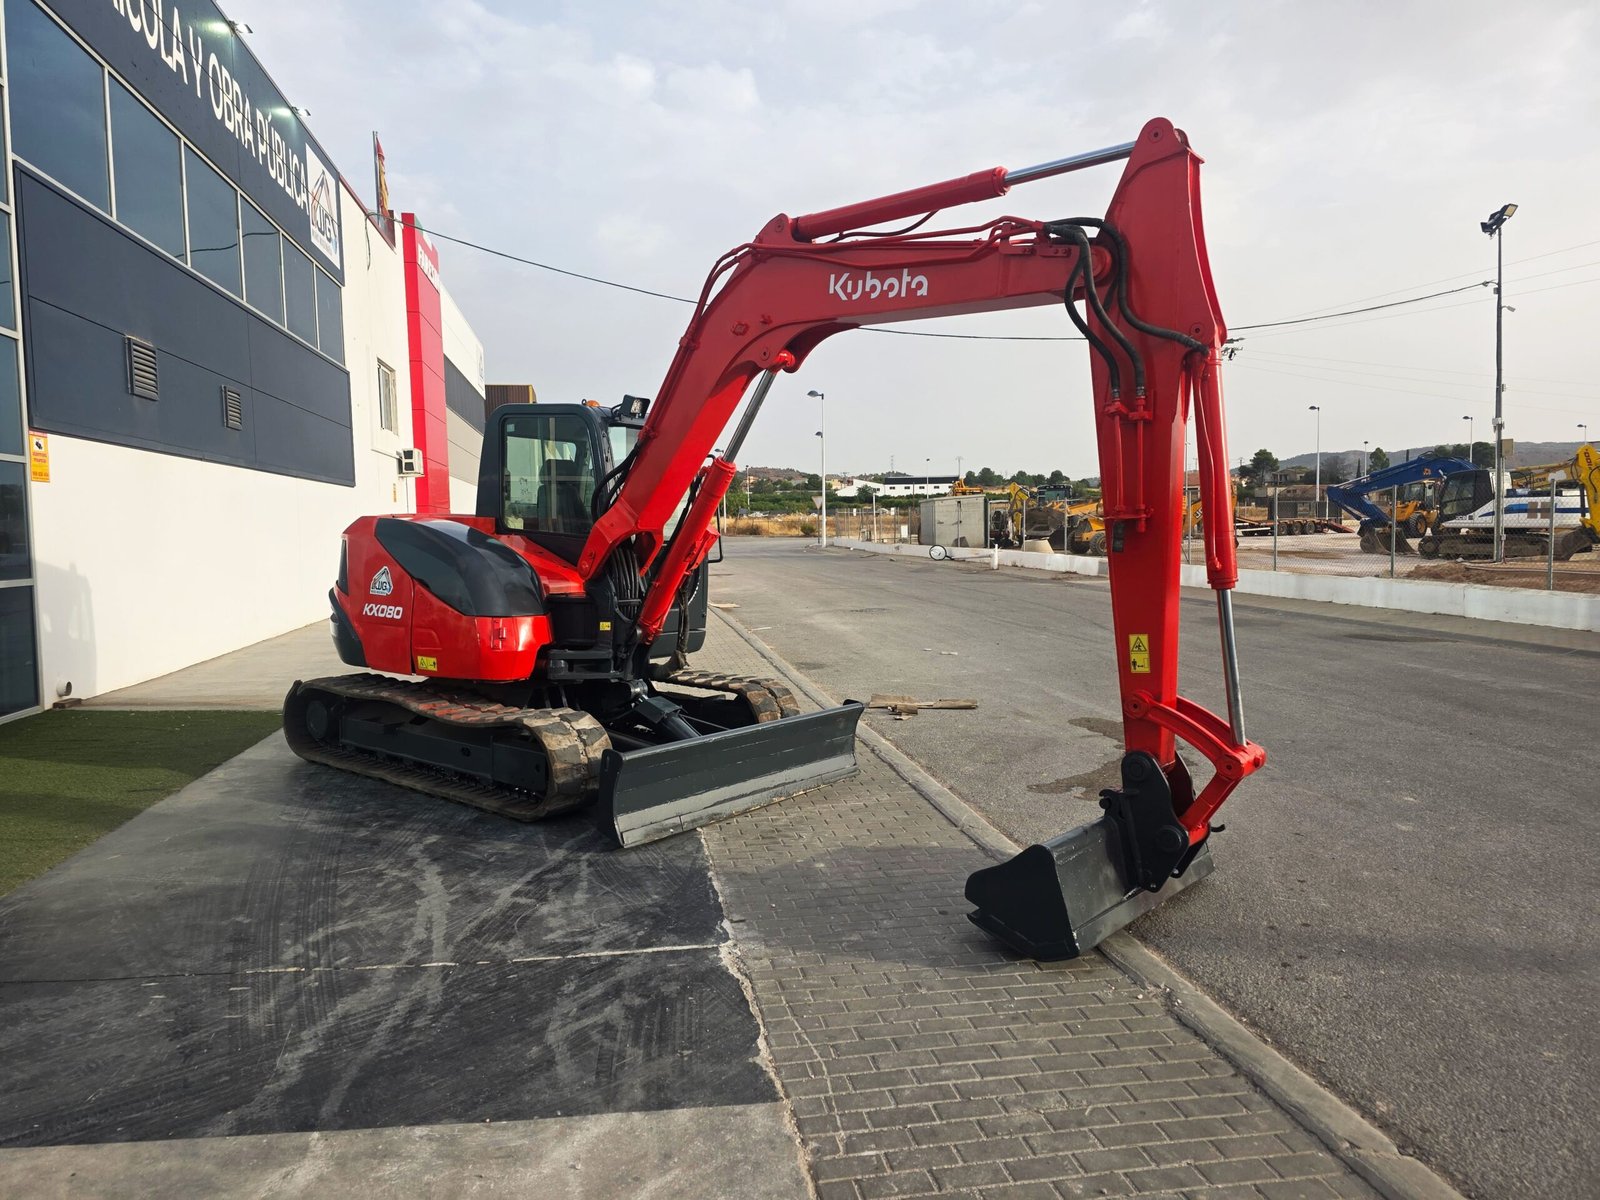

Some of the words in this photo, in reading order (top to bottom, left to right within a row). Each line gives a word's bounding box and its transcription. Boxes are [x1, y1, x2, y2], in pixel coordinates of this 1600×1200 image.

[112, 0, 188, 85] COLA
[189, 25, 203, 98] Y
[208, 52, 256, 158] OBRA
[256, 108, 310, 216] PÚBLICA
[828, 268, 929, 301] Kubota
[362, 603, 403, 619] KX080
